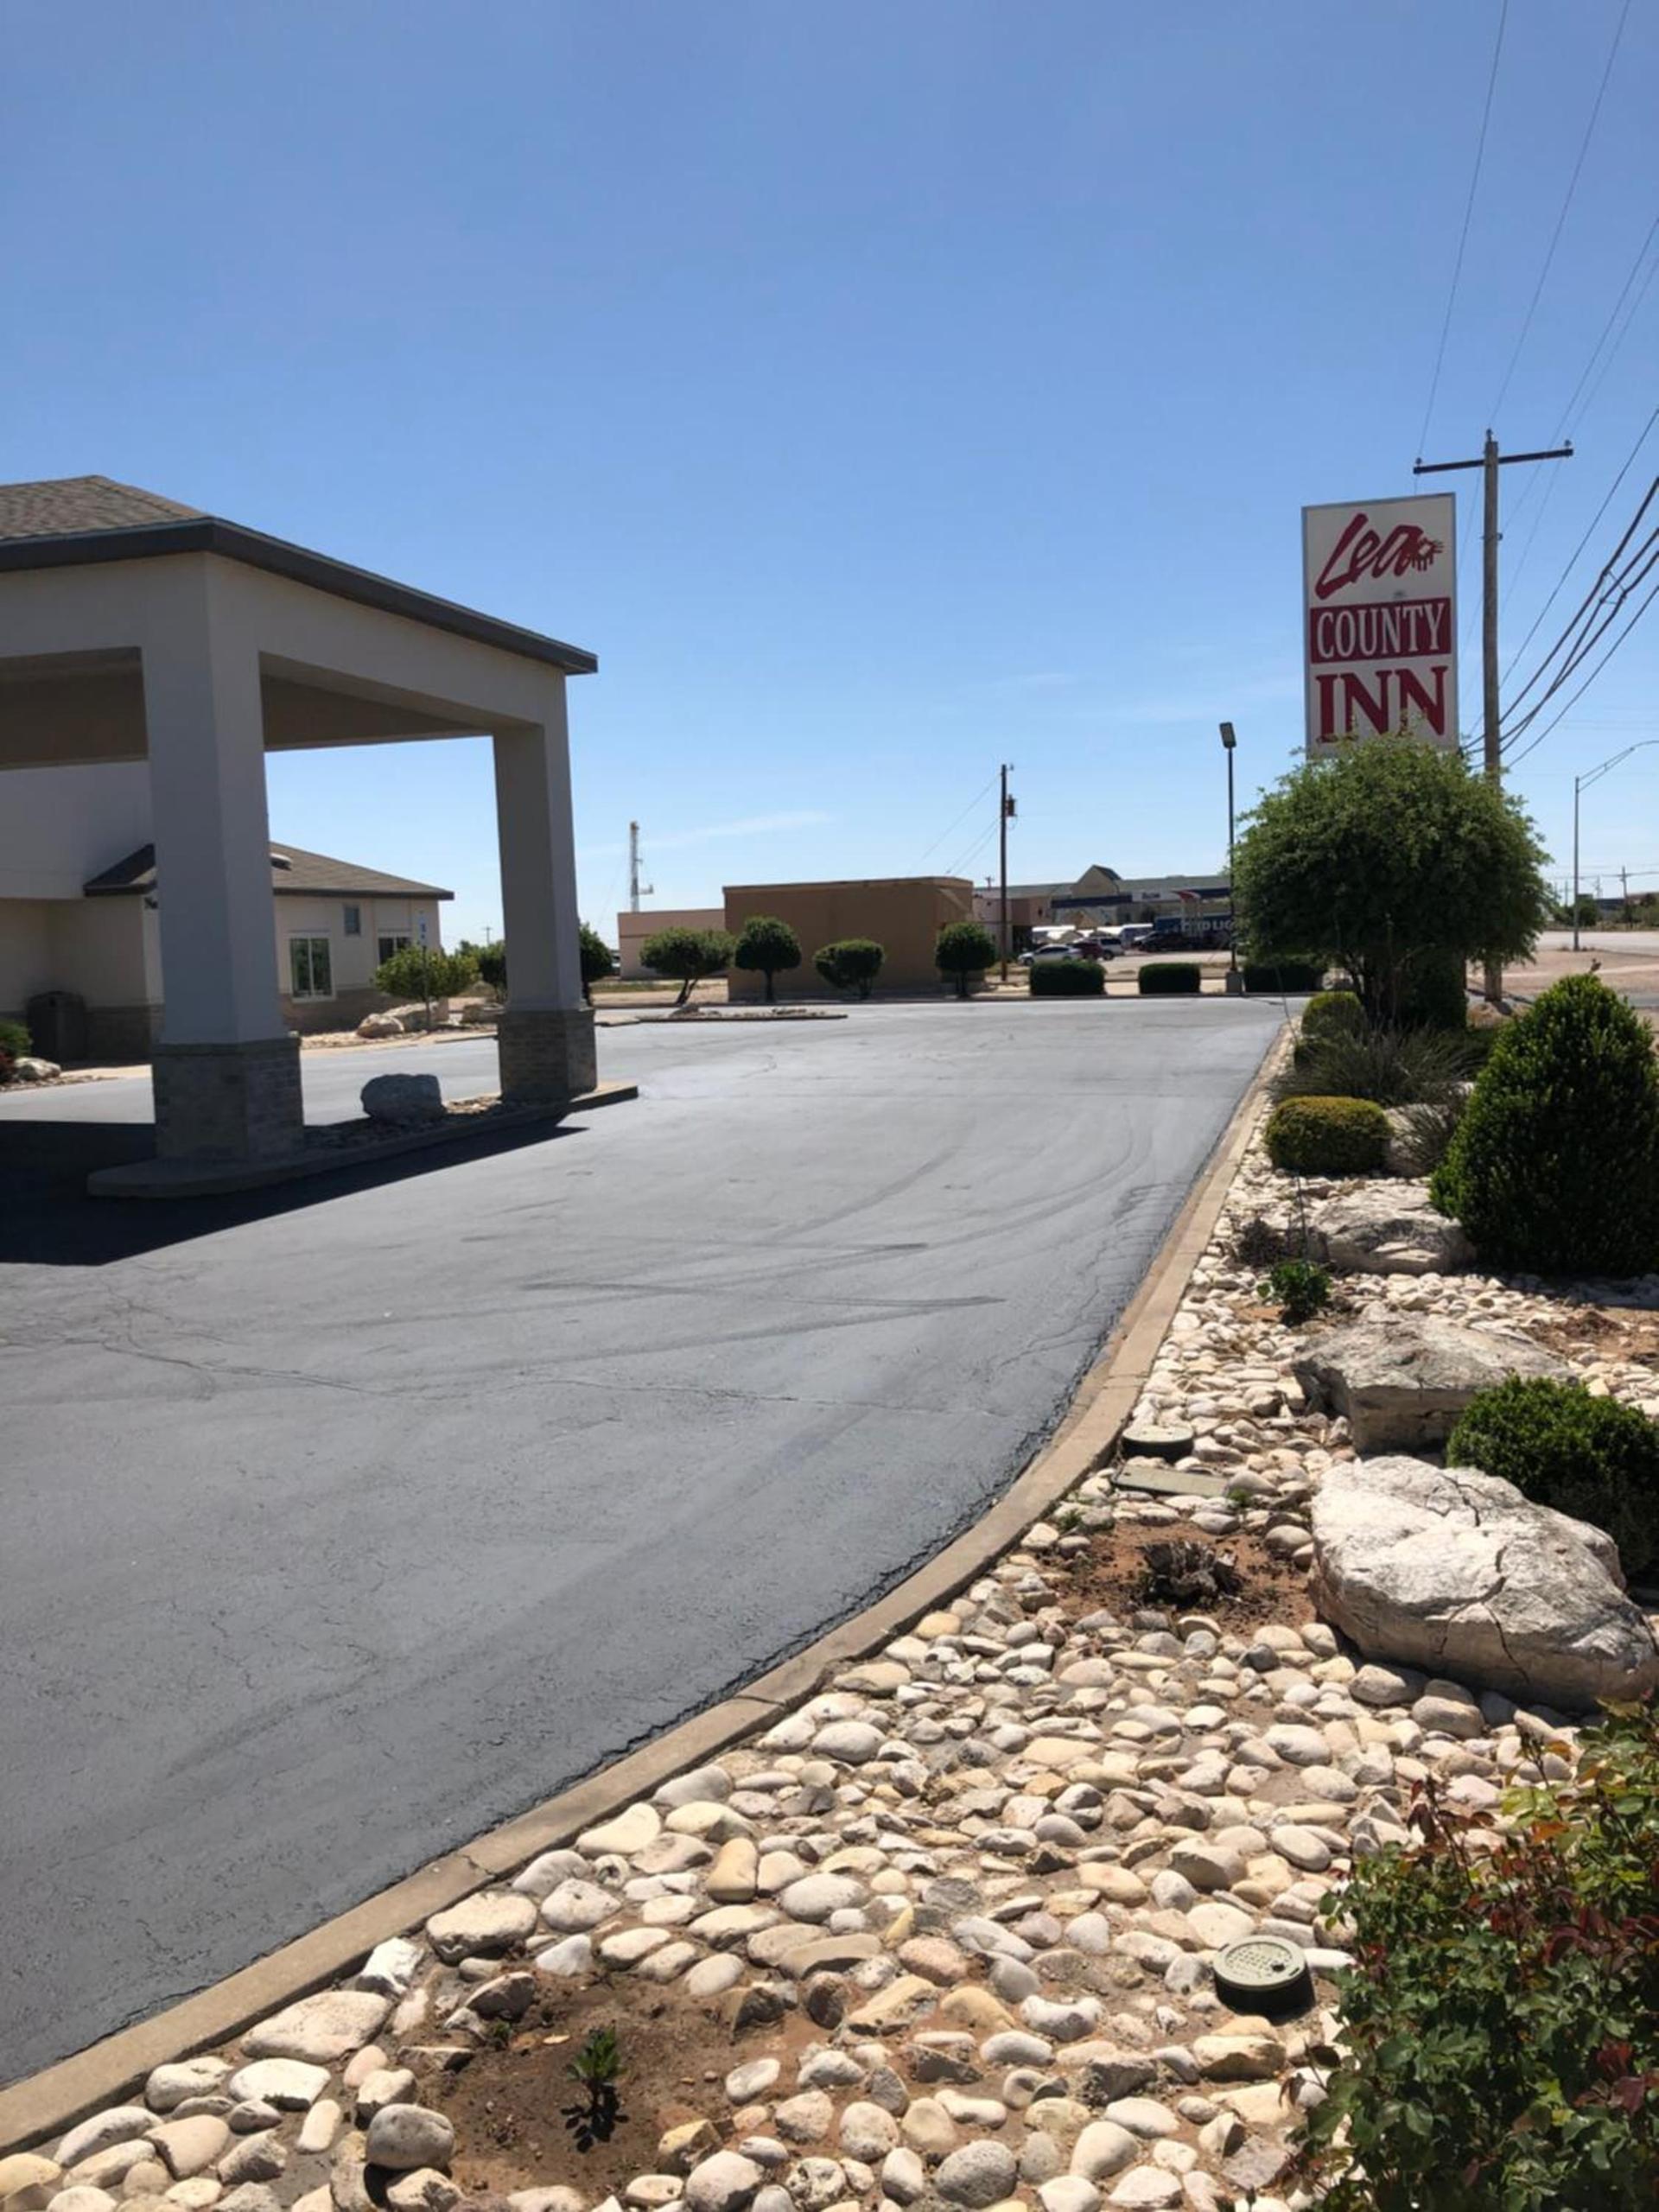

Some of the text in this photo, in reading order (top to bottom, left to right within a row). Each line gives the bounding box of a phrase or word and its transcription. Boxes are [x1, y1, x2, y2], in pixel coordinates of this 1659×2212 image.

[1314, 513, 1426, 600] Lea
[1317, 603, 1445, 658] COUNTY
[1315, 666, 1448, 743] INN
